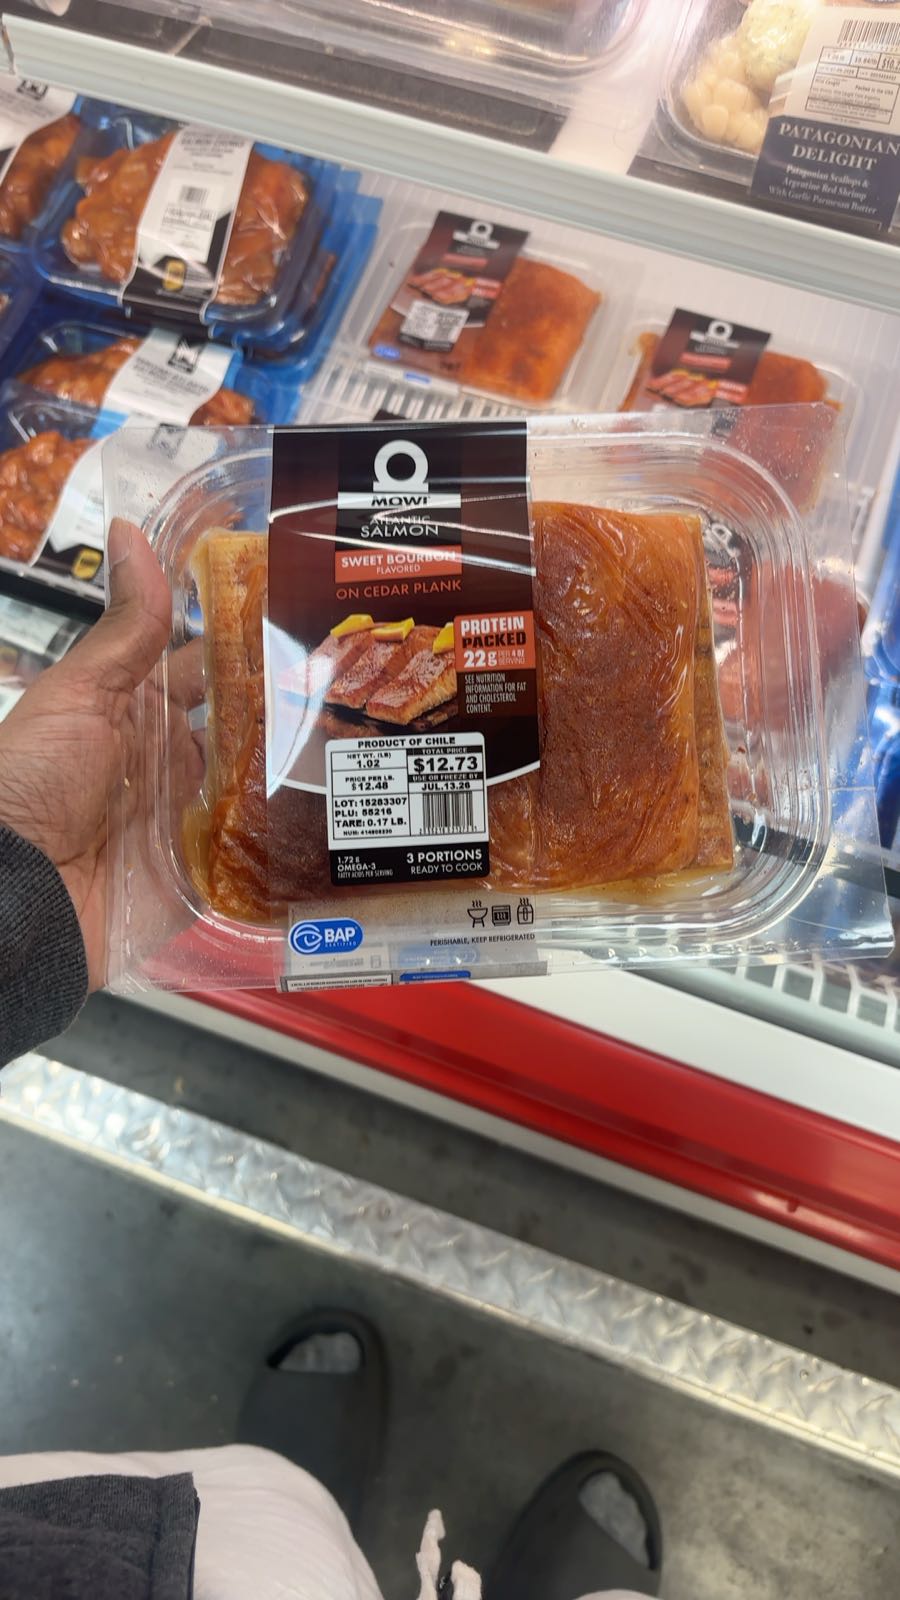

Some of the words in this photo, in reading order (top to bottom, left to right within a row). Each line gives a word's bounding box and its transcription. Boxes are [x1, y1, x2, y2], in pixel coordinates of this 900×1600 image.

[779, 122, 900, 156] PATAGONIAN
[792, 144, 877, 171] DELIGHT
[786, 164, 828, 181] Patagonian
[830, 172, 860, 188] Scallops
[861, 179, 869, 188] &
[783, 177, 820, 191] Argentine
[822, 183, 837, 194] Red
[838, 187, 867, 203] Shrimp
[850, 201, 877, 214] Butter
[371, 495, 428, 506] MOWI
[361, 525, 439, 538] SALMON
[342, 554, 383, 568] SWEET
[376, 564, 421, 575] FLAVORED
[336, 588, 359, 600] ON
[363, 583, 409, 598] CEDAR
[414, 579, 462, 593] PLANK
[461, 616, 524, 637] PROTEIN
[462, 632, 527, 648] PACKED
[465, 674, 474, 684] SEE
[476, 673, 505, 683] NUTRITION
[465, 683, 504, 694] INFORMATION
[505, 682, 515, 692] FOR
[517, 682, 526, 691] FAT
[466, 694, 478, 704] AND
[479, 692, 516, 703] CHOLESTEROL
[466, 703, 492, 714] CONTENT.
[358, 738, 406, 749] PRODUCT
[408, 737, 422, 746] OF
[425, 736, 456, 745] CHILE
[357, 760, 380, 768] 1.02
[413, 756, 478, 775] $12.73
[351, 781, 388, 791] $12.48
[334, 800, 358, 808] LOT:
[334, 810, 358, 818] PLU:
[335, 819, 365, 828] TARE:
[367, 818, 388, 827] 0.17
[391, 817, 407, 826] LB.
[337, 856, 354, 864] 1.72
[406, 853, 414, 864] 3
[418, 849, 482, 863] PORTIONS
[337, 862, 376, 872] OMEGA-3
[411, 864, 440, 875] READY
[442, 863, 453, 873] TO
[455, 862, 483, 872] COOK
[324, 927, 356, 943] BAP
[430, 937, 470, 946] PERISHABLE,
[471, 936, 488, 944] KEEP
[488, 933, 536, 943] REFRIGERATED
